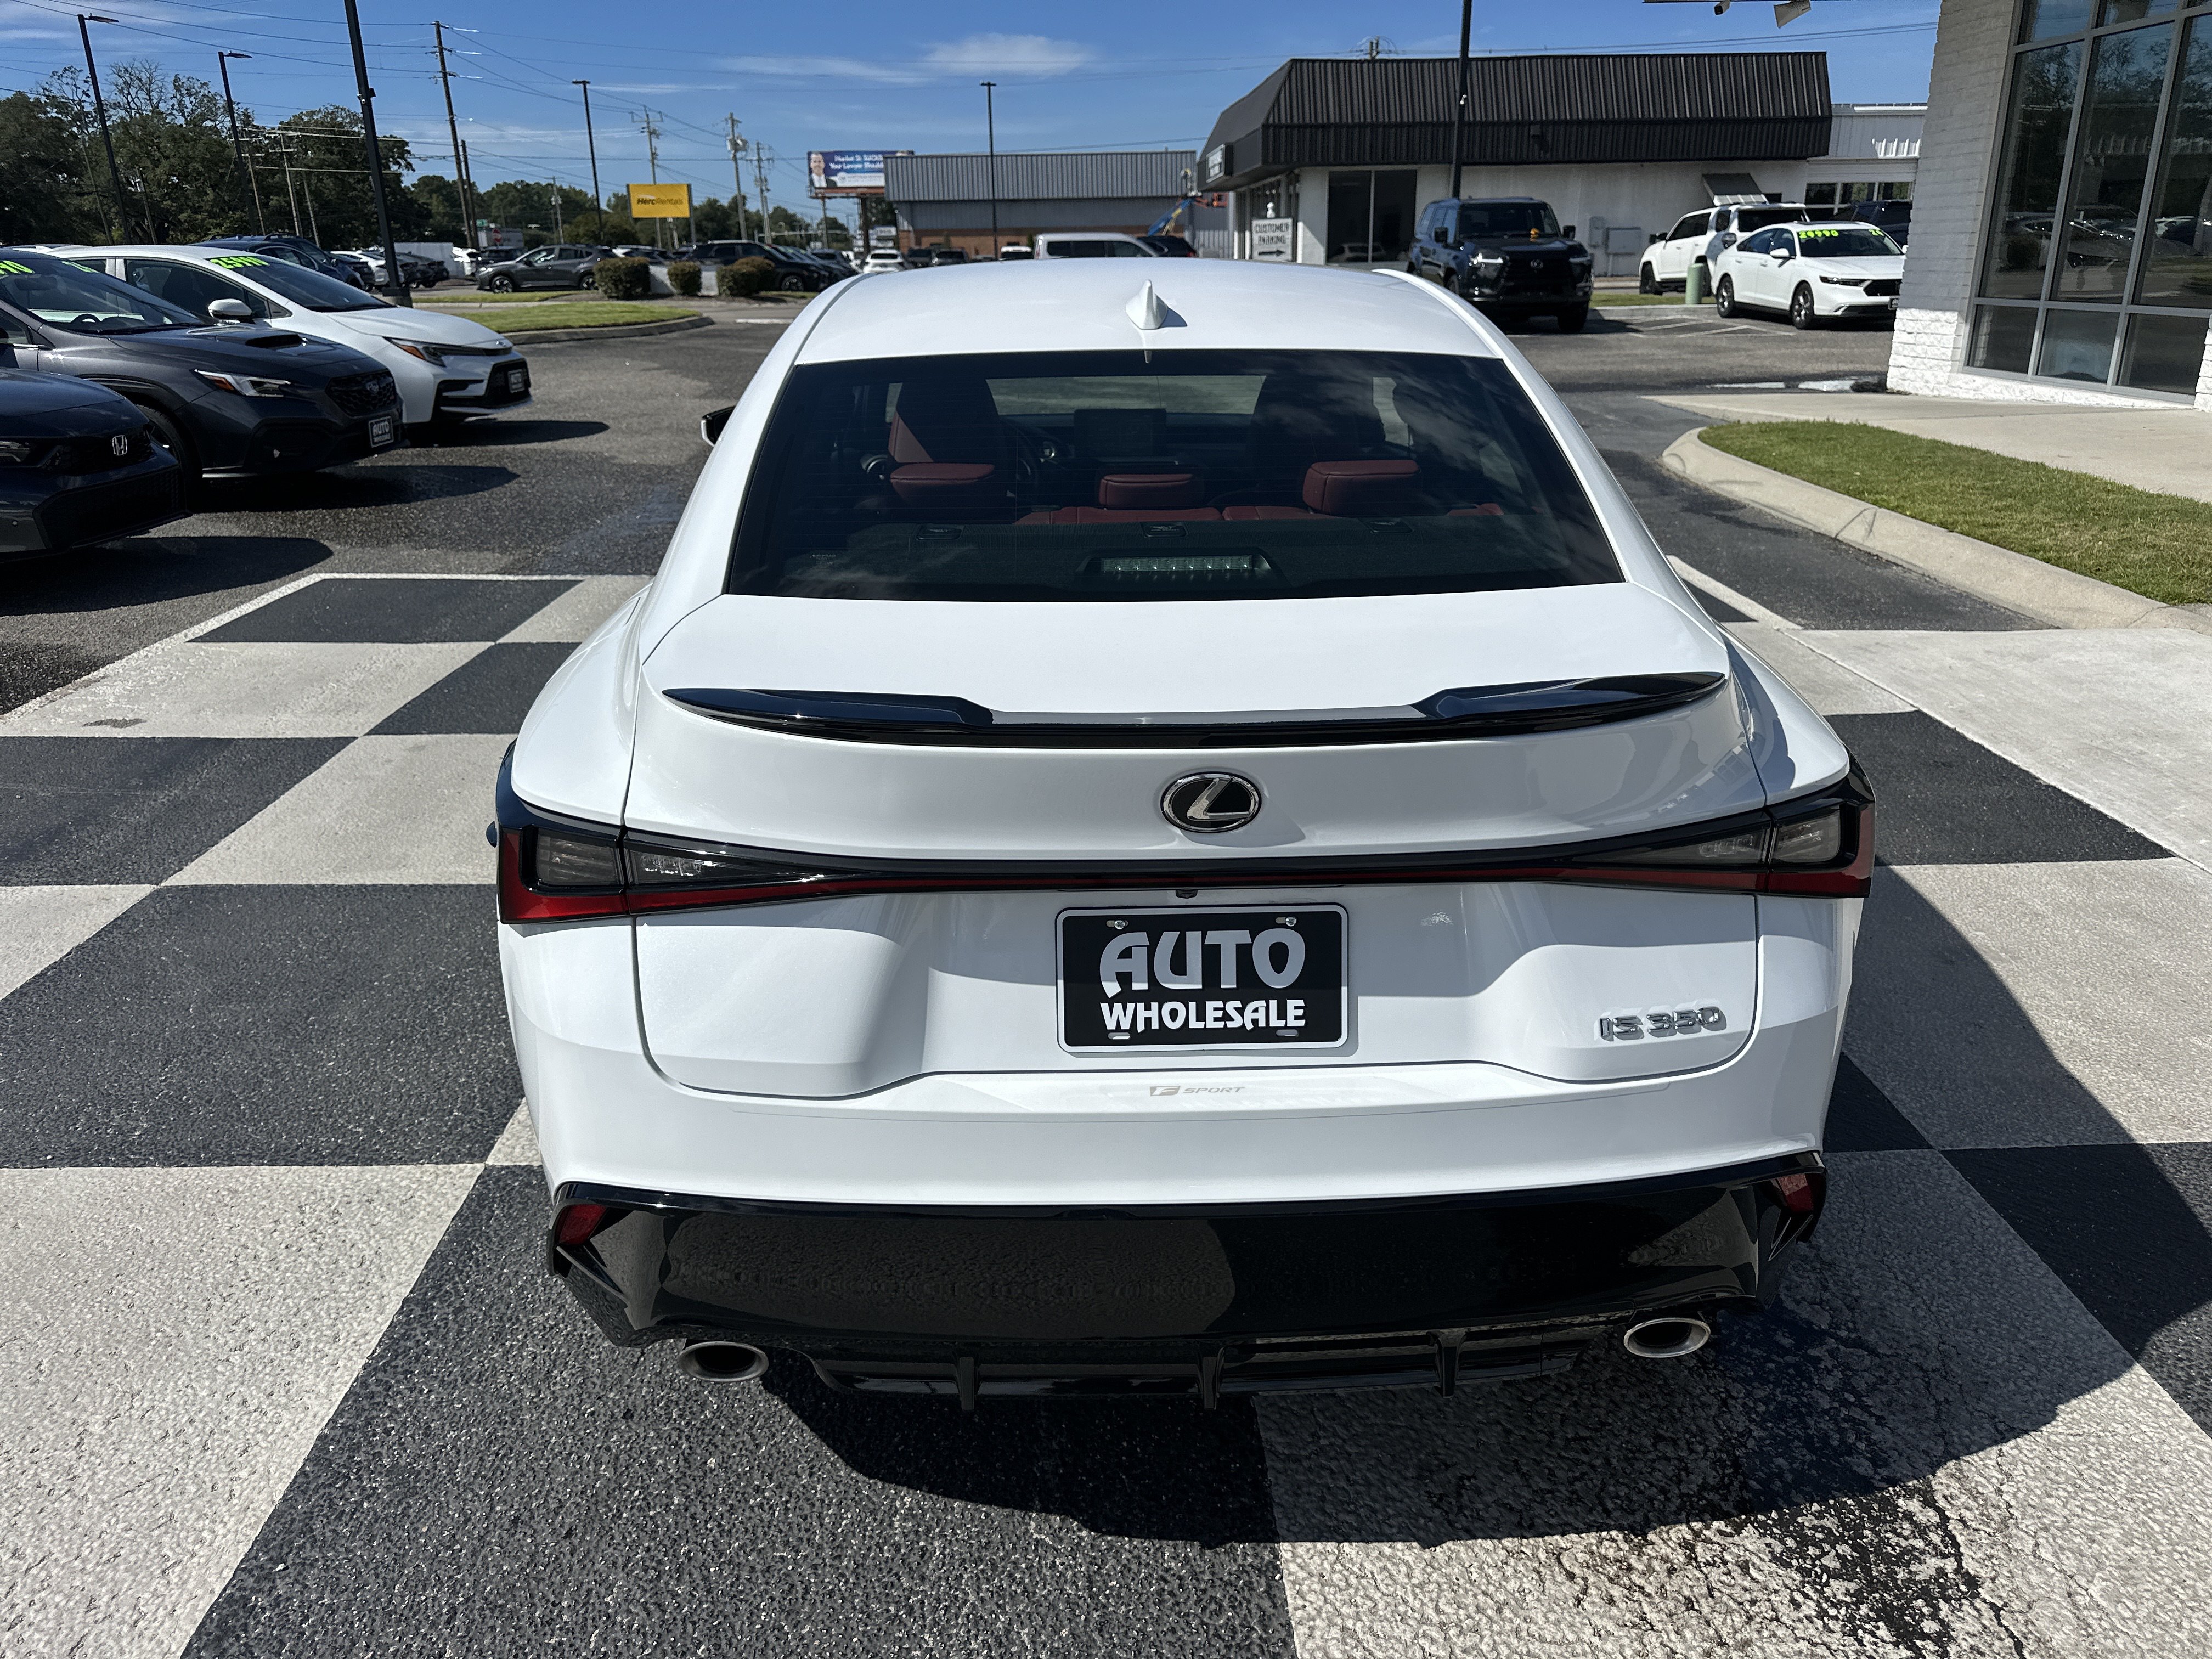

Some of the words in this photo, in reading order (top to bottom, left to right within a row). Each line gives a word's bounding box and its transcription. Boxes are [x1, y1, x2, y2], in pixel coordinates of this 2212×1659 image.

[1254, 222, 1290, 233] CUSTOMER
[1258, 235, 1286, 245] PARKING
[1099, 928, 1306, 998] AUTO
[1100, 999, 1306, 1033] WHOLESALE
[1599, 1015, 1644, 1038] IS
[1646, 1006, 1722, 1032] 350
